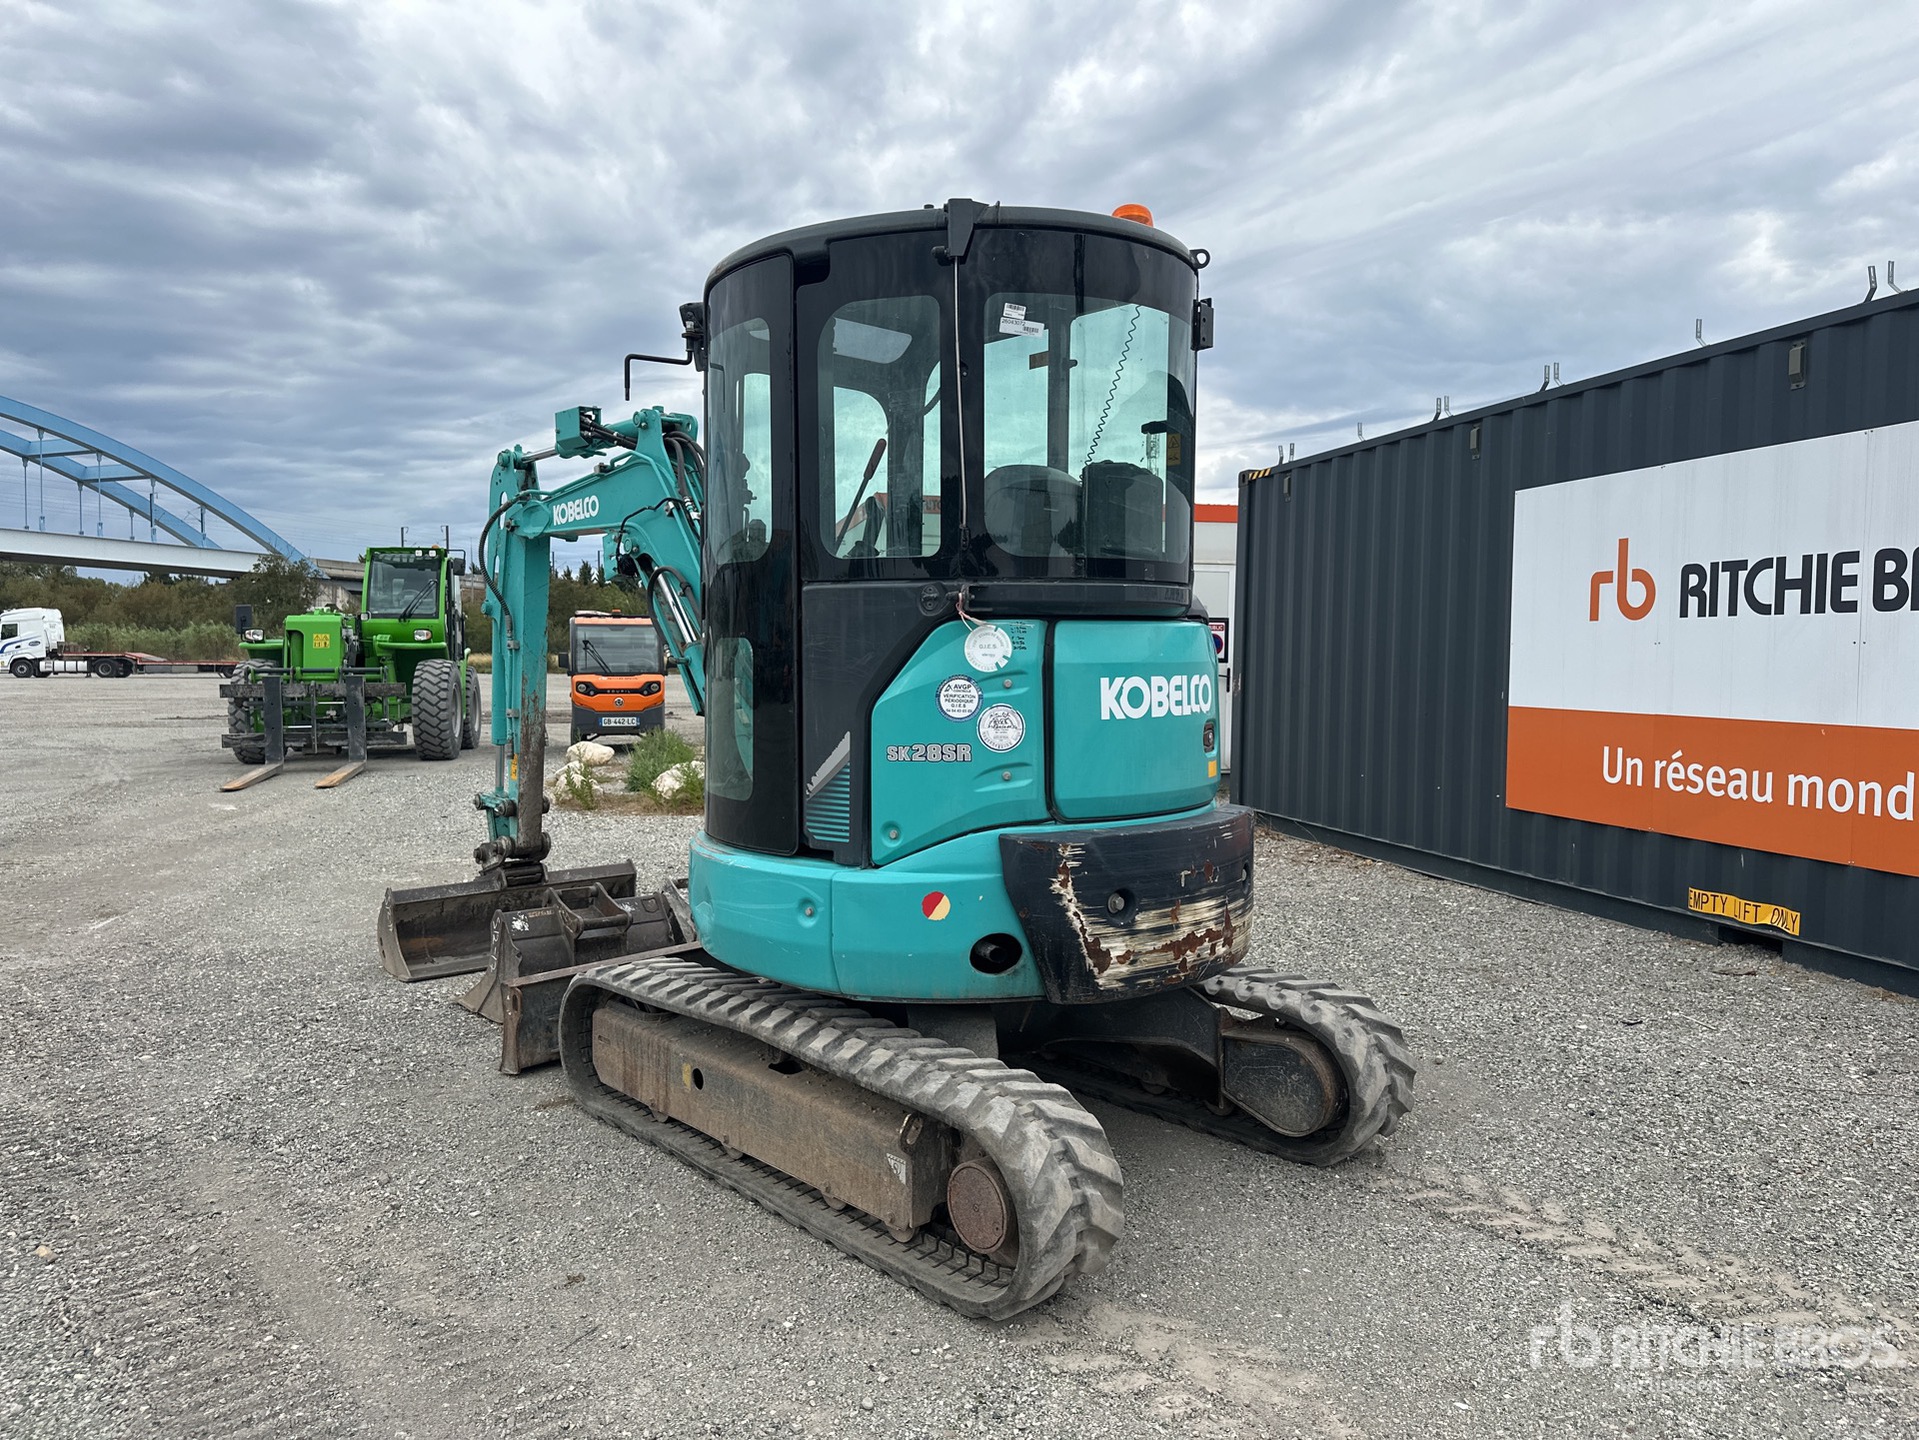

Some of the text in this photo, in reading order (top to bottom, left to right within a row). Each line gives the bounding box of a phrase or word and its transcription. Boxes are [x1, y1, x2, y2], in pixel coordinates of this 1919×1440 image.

[552, 495, 599, 526] KOBELCO
[1679, 550, 1860, 618] RITCHIE
[1872, 547, 1919, 612] B
[1100, 674, 1212, 720] KOBELCO
[886, 743, 973, 763] SK28SR
[1603, 746, 1914, 821] Un réseau mond
[1689, 889, 1798, 932] EMPTY LIFT ONLY
